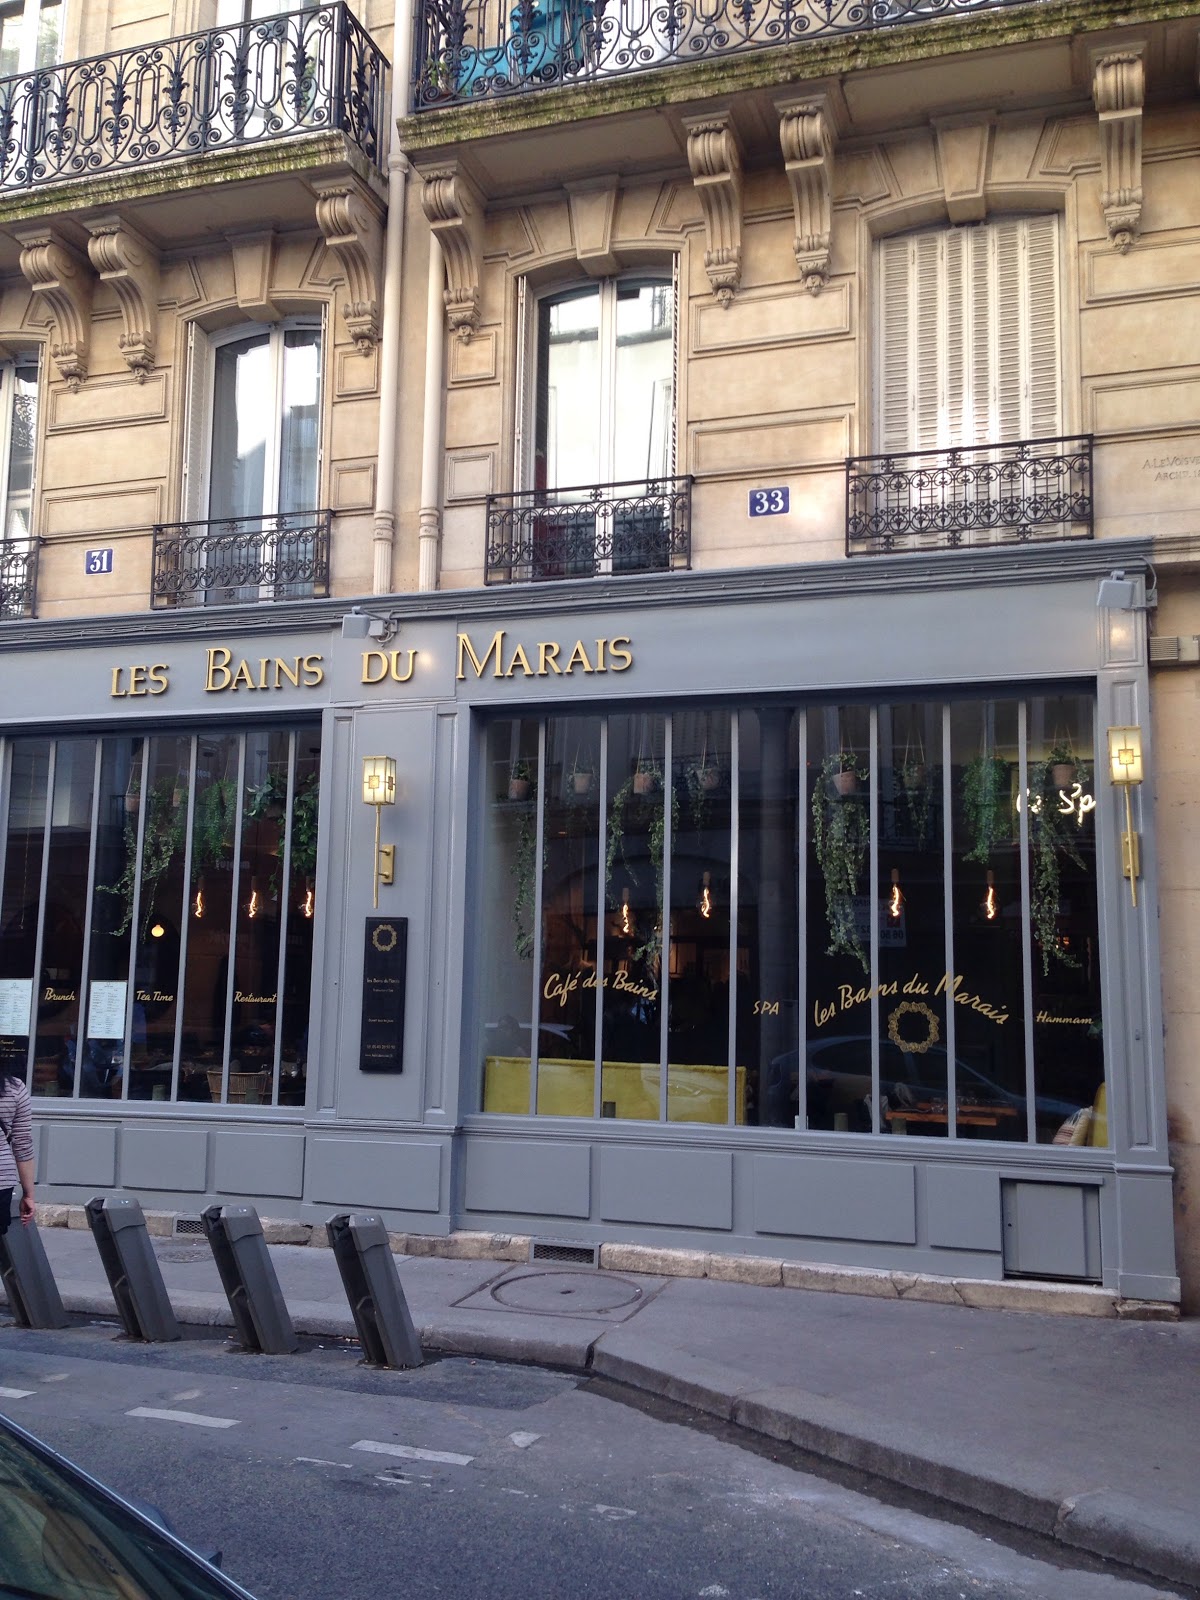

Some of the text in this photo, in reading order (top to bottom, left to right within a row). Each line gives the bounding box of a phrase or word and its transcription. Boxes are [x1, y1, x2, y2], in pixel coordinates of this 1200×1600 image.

[756, 490, 784, 514] 33
[90, 551, 108, 572] 31
[110, 630, 633, 697] LES BAINS DU MARAIS
[44, 987, 76, 1001] Brunch
[136, 990, 174, 1002] Tea Time
[234, 991, 277, 1003] Restaurant
[543, 970, 658, 1007] Café des Bains
[838, 980, 898, 1010] Bains
[902, 972, 929, 995] du
[933, 971, 1010, 1025] Marais
[752, 1000, 779, 1016] SPA
[1036, 1010, 1094, 1025] Hammam
